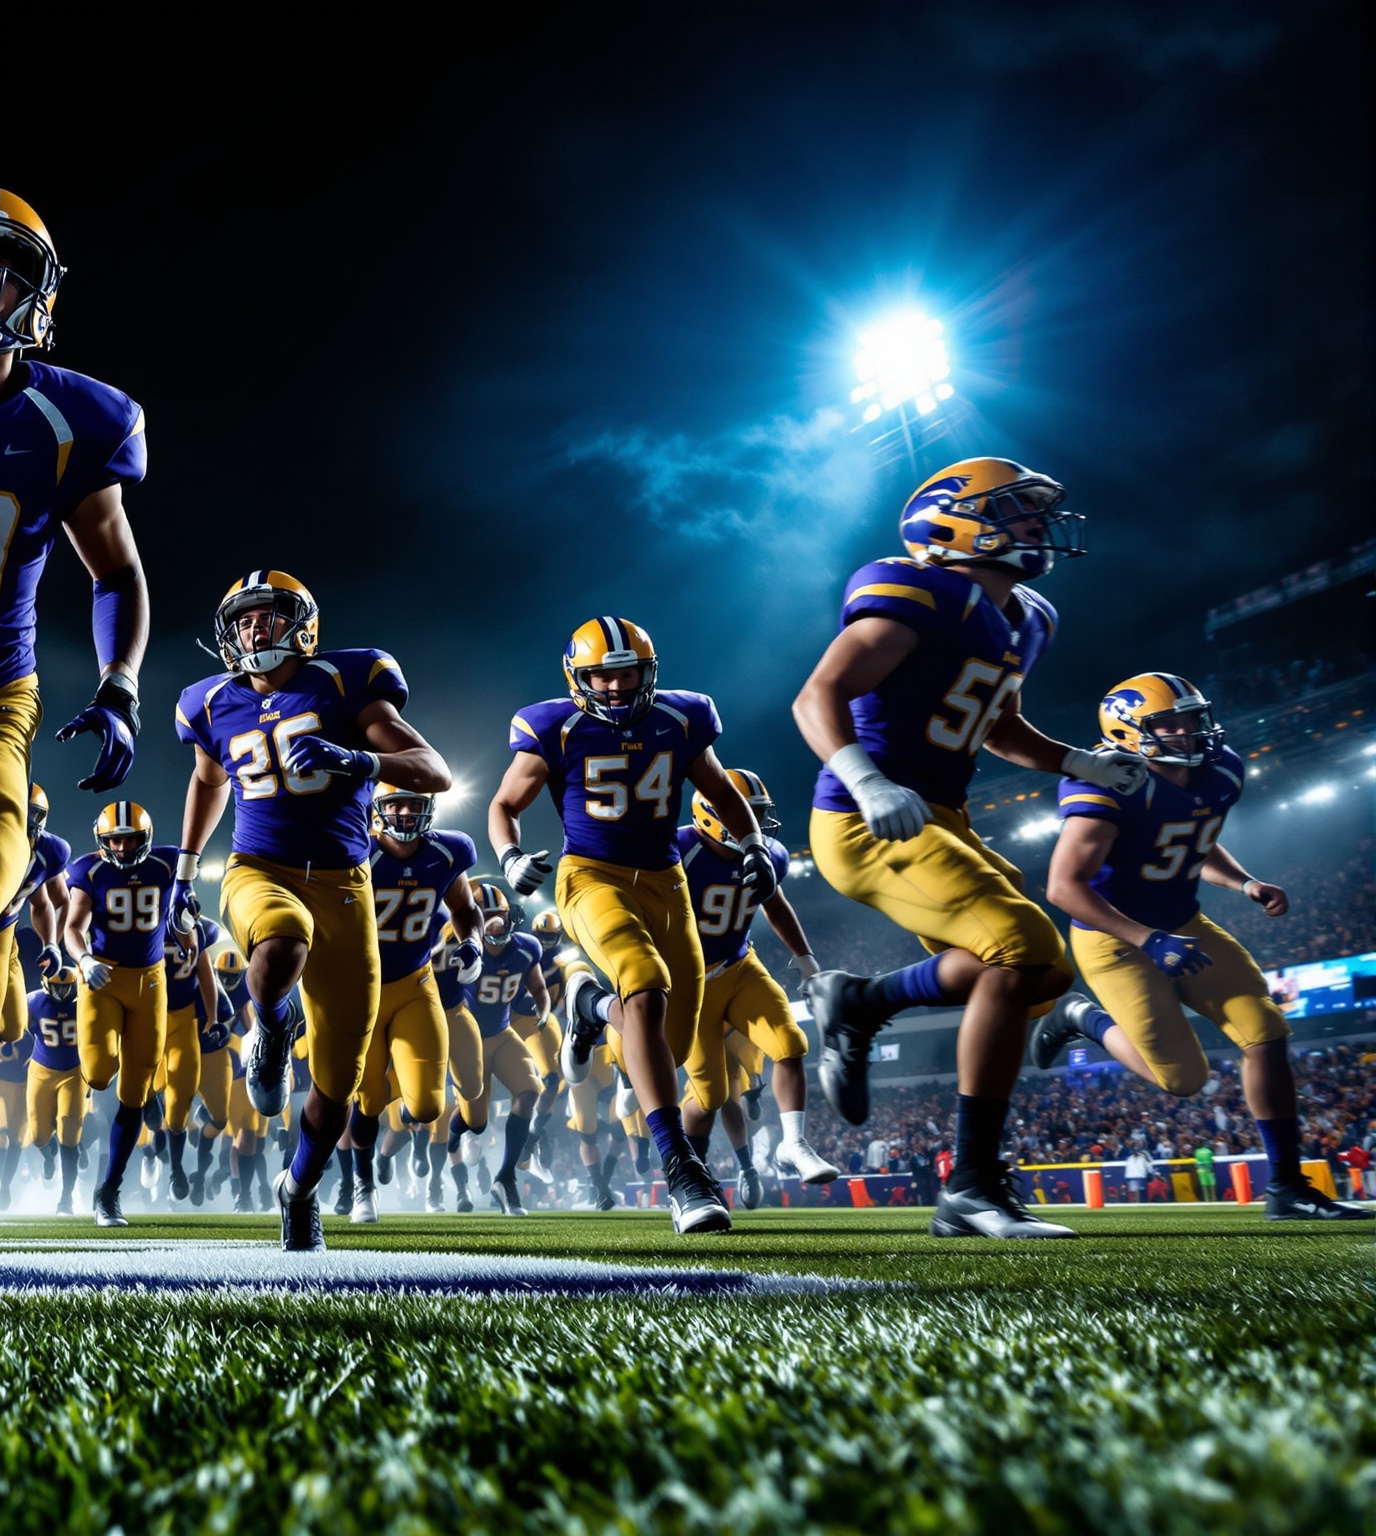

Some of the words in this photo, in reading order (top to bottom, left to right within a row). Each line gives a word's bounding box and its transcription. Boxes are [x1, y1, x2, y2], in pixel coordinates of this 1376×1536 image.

[229, 711, 332, 800] 26
[584, 751, 673, 821] 54
[106, 886, 161, 931] 99
